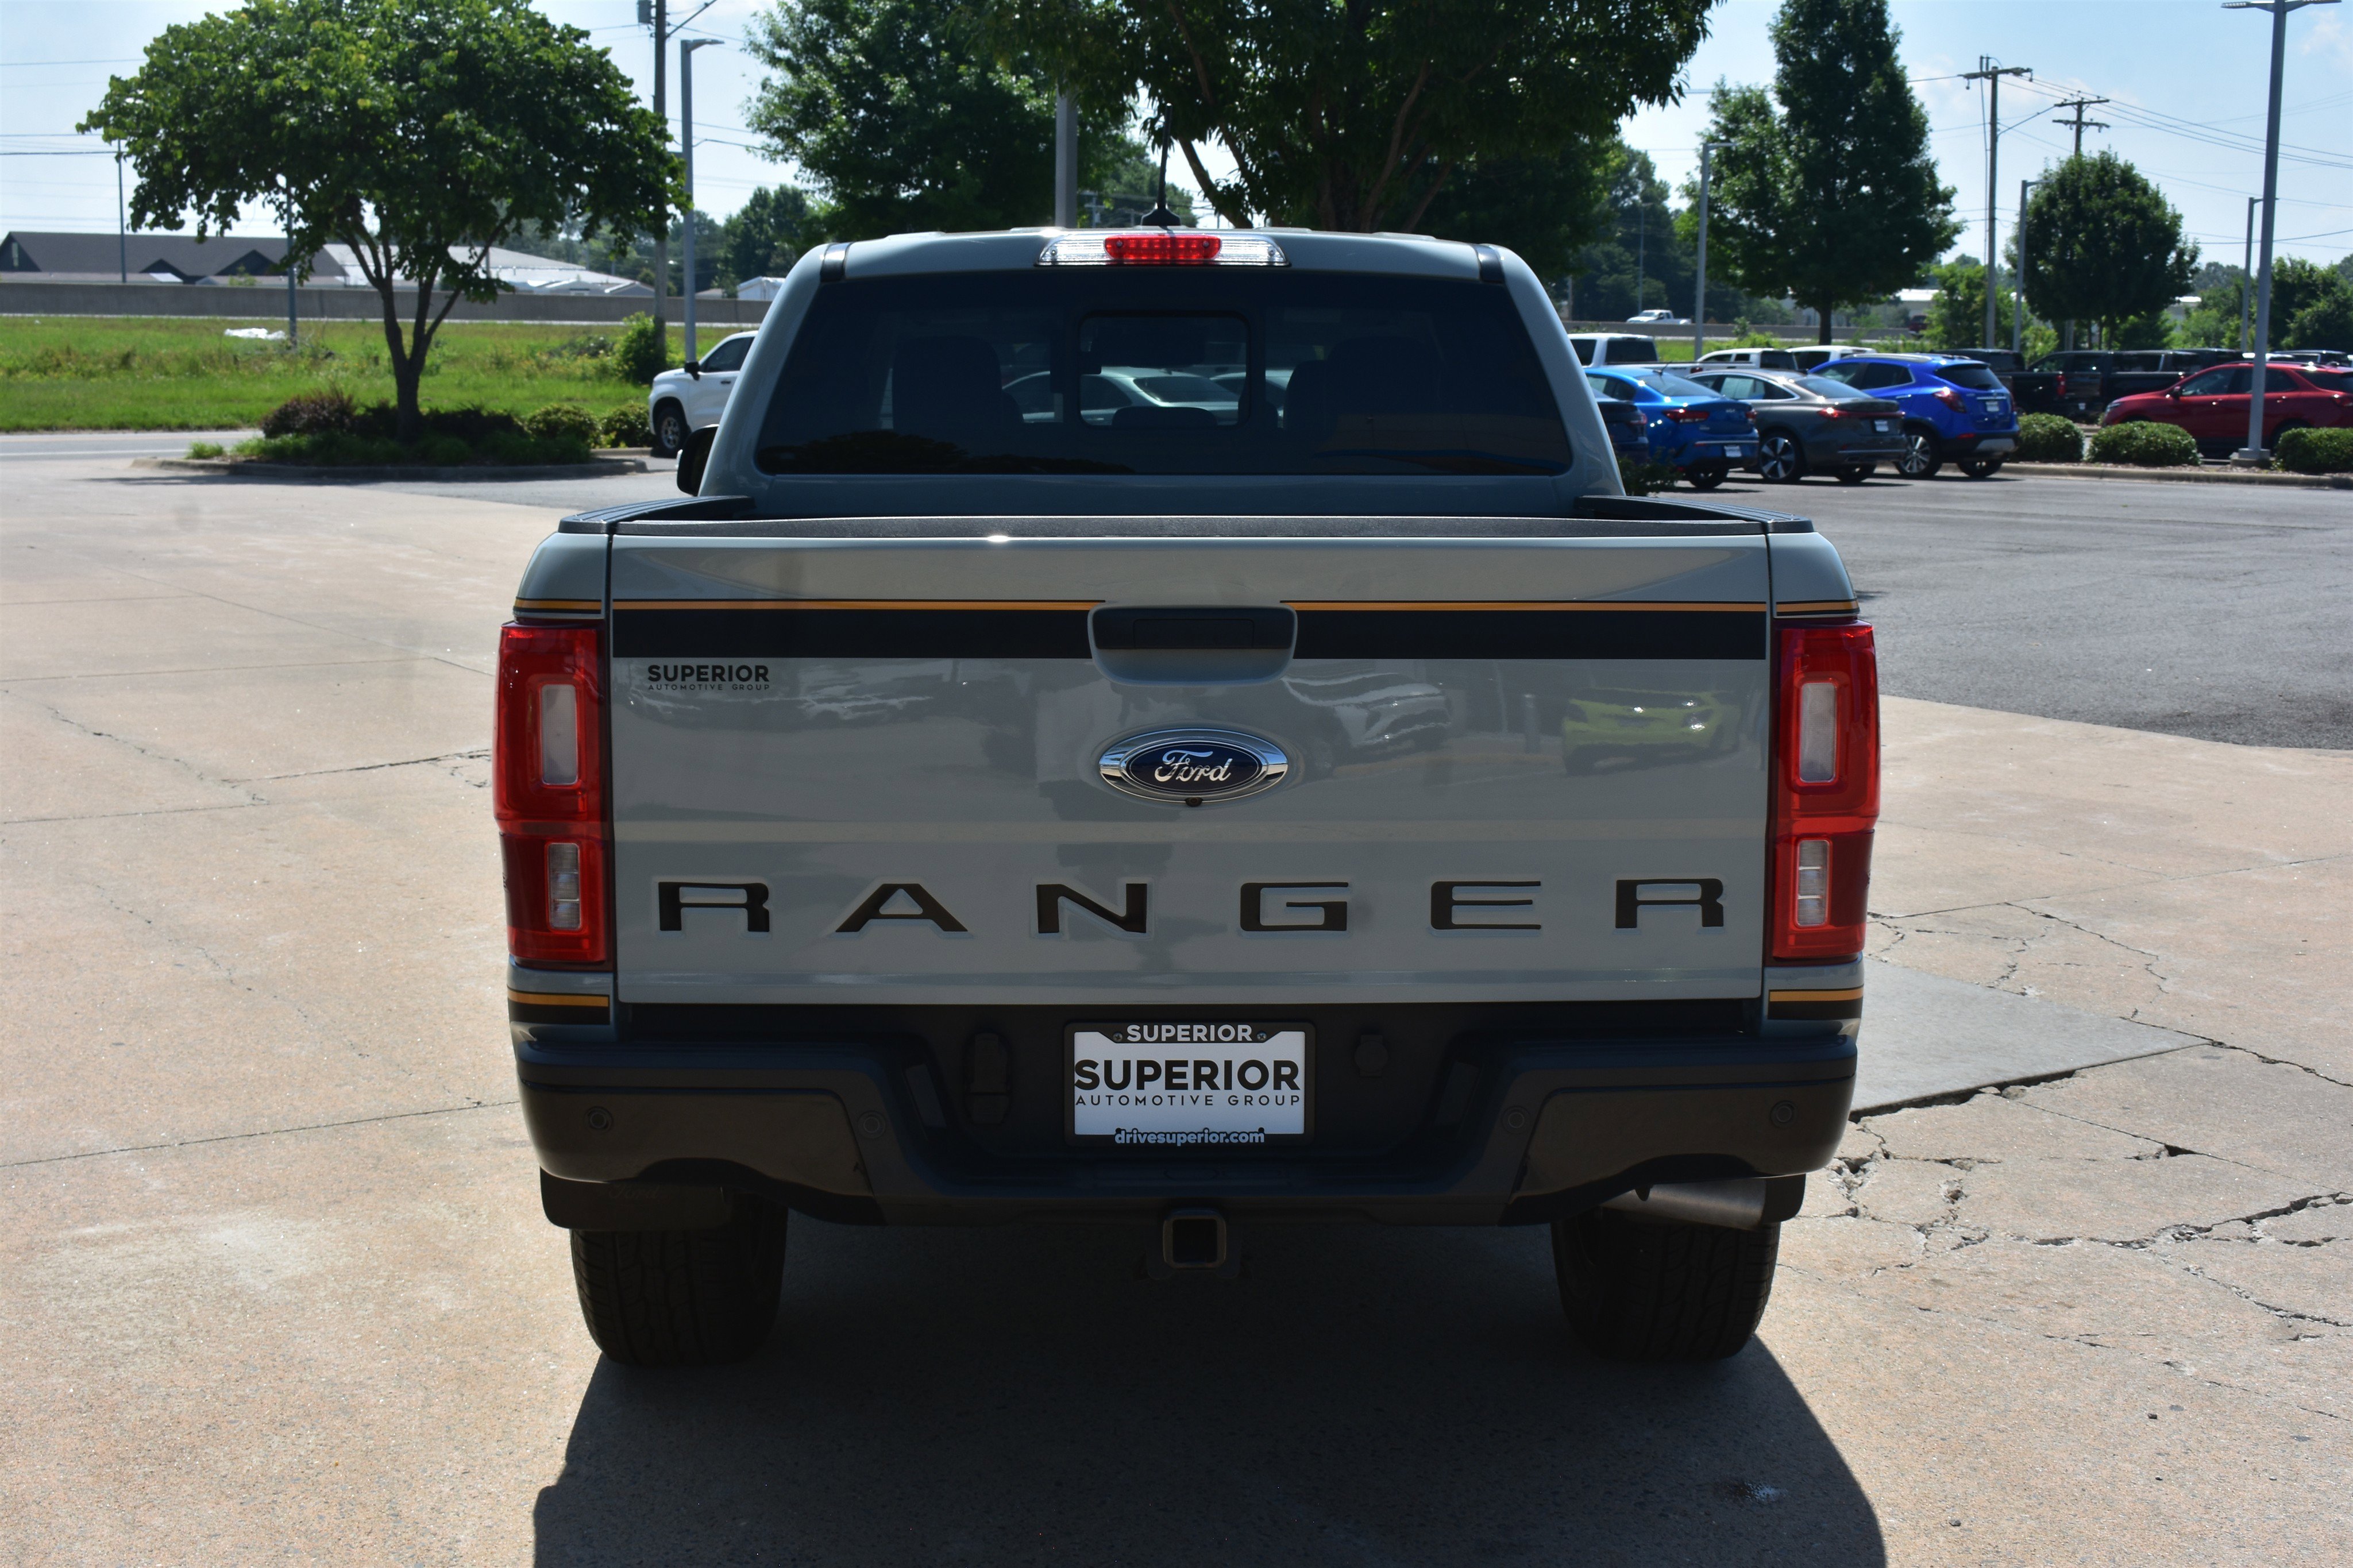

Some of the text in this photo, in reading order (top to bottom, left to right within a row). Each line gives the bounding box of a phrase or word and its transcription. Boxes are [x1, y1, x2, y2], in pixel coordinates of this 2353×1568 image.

[647, 665, 769, 682] SUPERIOR
[1154, 750, 1233, 782] Ford
[658, 878, 1724, 933] RANGER
[1127, 1025, 1252, 1042] SUPERIOR
[1074, 1059, 1301, 1091] SUPERIOR
[1075, 1095, 1300, 1106] AUTOMOTIVE GROUP
[1114, 1128, 1264, 1146] drivesuperior.com
